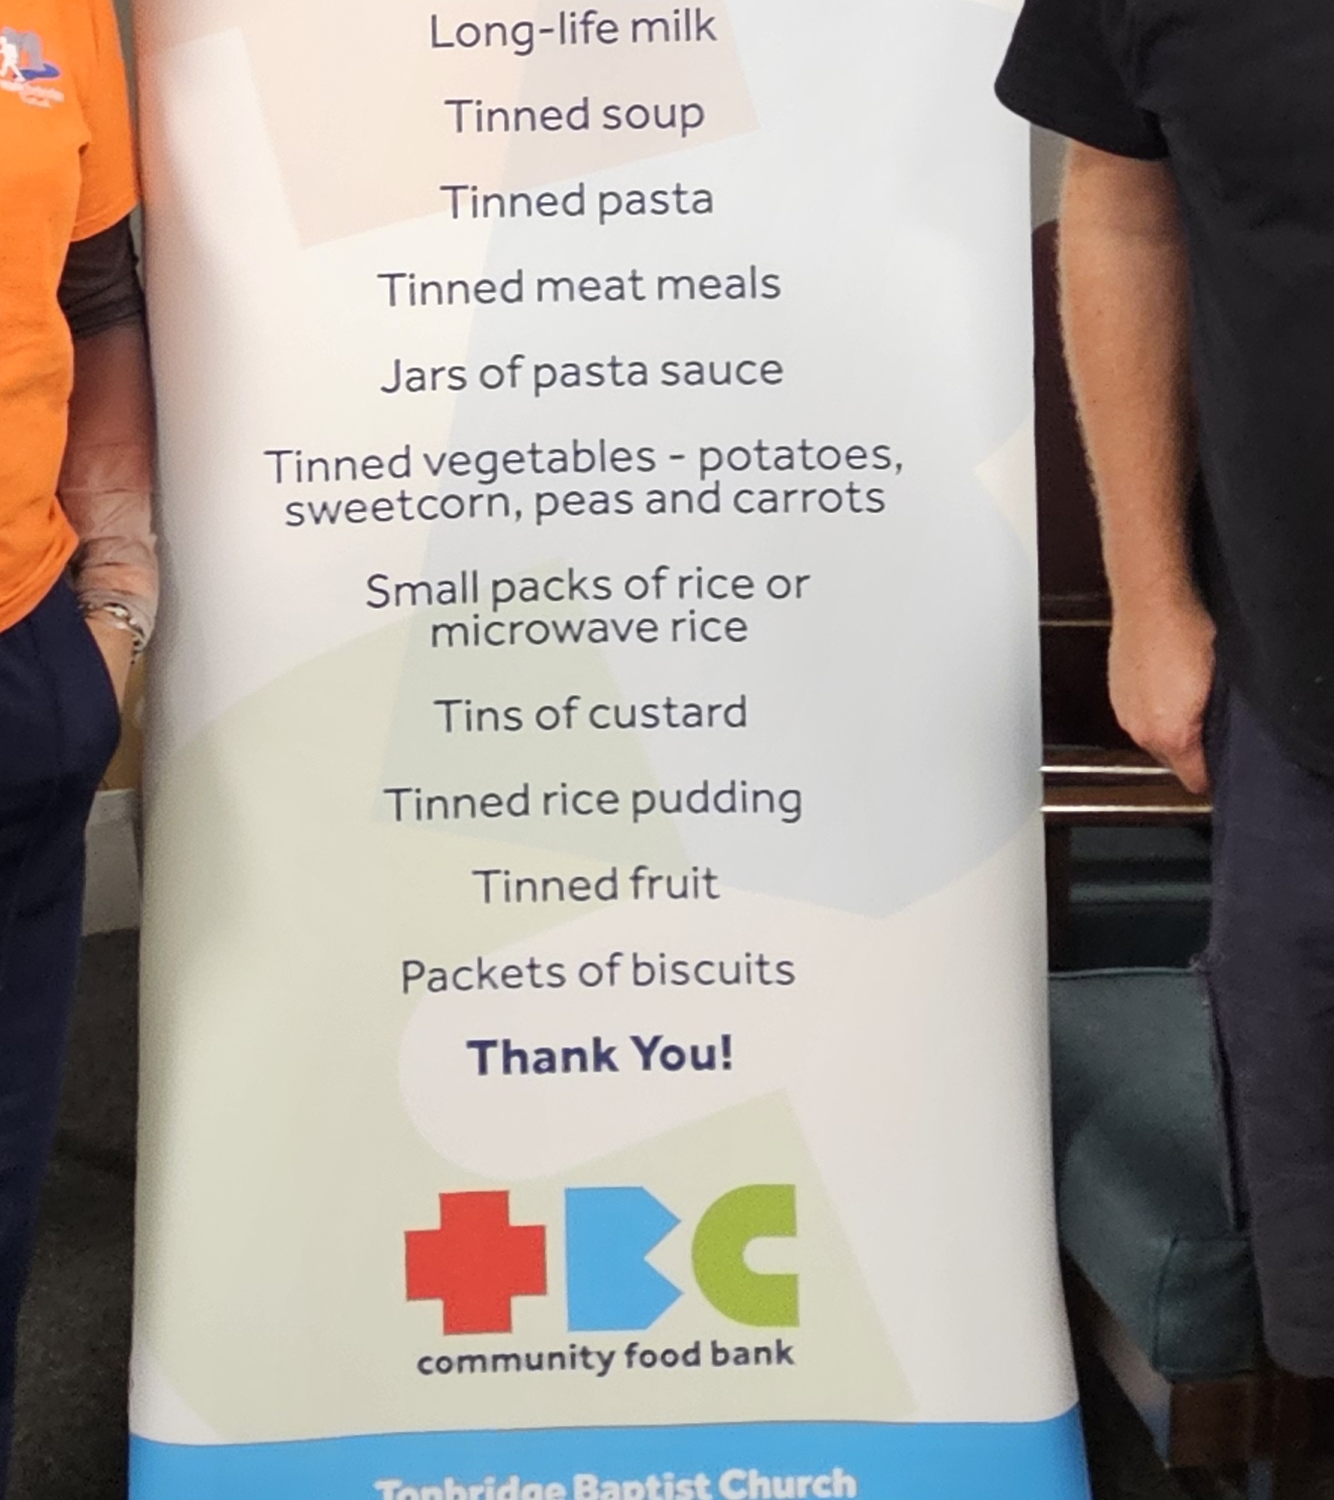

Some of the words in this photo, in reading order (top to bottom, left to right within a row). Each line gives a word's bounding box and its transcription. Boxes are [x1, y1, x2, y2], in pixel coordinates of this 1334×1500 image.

[430, 8, 619, 56] Long-life
[630, 7, 718, 44] milk
[444, 97, 590, 134] Tinned
[602, 102, 706, 139] soup
[439, 181, 586, 220] Tinned
[599, 183, 714, 226] pasta
[377, 269, 524, 308] Tinned
[536, 268, 647, 303] meat
[657, 264, 782, 301] meals
[380, 358, 468, 394] Jars
[479, 353, 526, 390] of
[534, 355, 649, 398] pasta
[660, 359, 784, 387] sauce
[263, 443, 412, 485] Tinned
[422, 438, 657, 486] vegetables
[699, 438, 904, 482] potatoes,
[285, 488, 524, 528] sweetcorn,
[535, 488, 634, 527] peas
[646, 479, 721, 516] and
[732, 479, 886, 516] carrots
[366, 569, 479, 610] Small
[491, 566, 613, 614] packs
[624, 564, 671, 601] of
[678, 564, 755, 601] rice
[766, 574, 812, 601] or
[431, 612, 659, 649] microwave
[671, 608, 749, 644] rice
[433, 697, 524, 734] Tins
[535, 694, 582, 731] of
[589, 693, 747, 731] custard
[383, 782, 530, 823] Tinned
[543, 781, 620, 817] rice
[631, 779, 803, 824] pudding
[471, 866, 619, 905] Tinned
[628, 864, 721, 901] fruit
[402, 956, 567, 995] Packets
[578, 952, 623, 989] of
[632, 950, 796, 988] biscuits
[466, 1036, 620, 1077] Thank
[628, 1033, 734, 1073] You!
[416, 1342, 616, 1378] community
[624, 1338, 702, 1370] food
[710, 1336, 796, 1368] bank
[718, 1467, 858, 1500] Church
